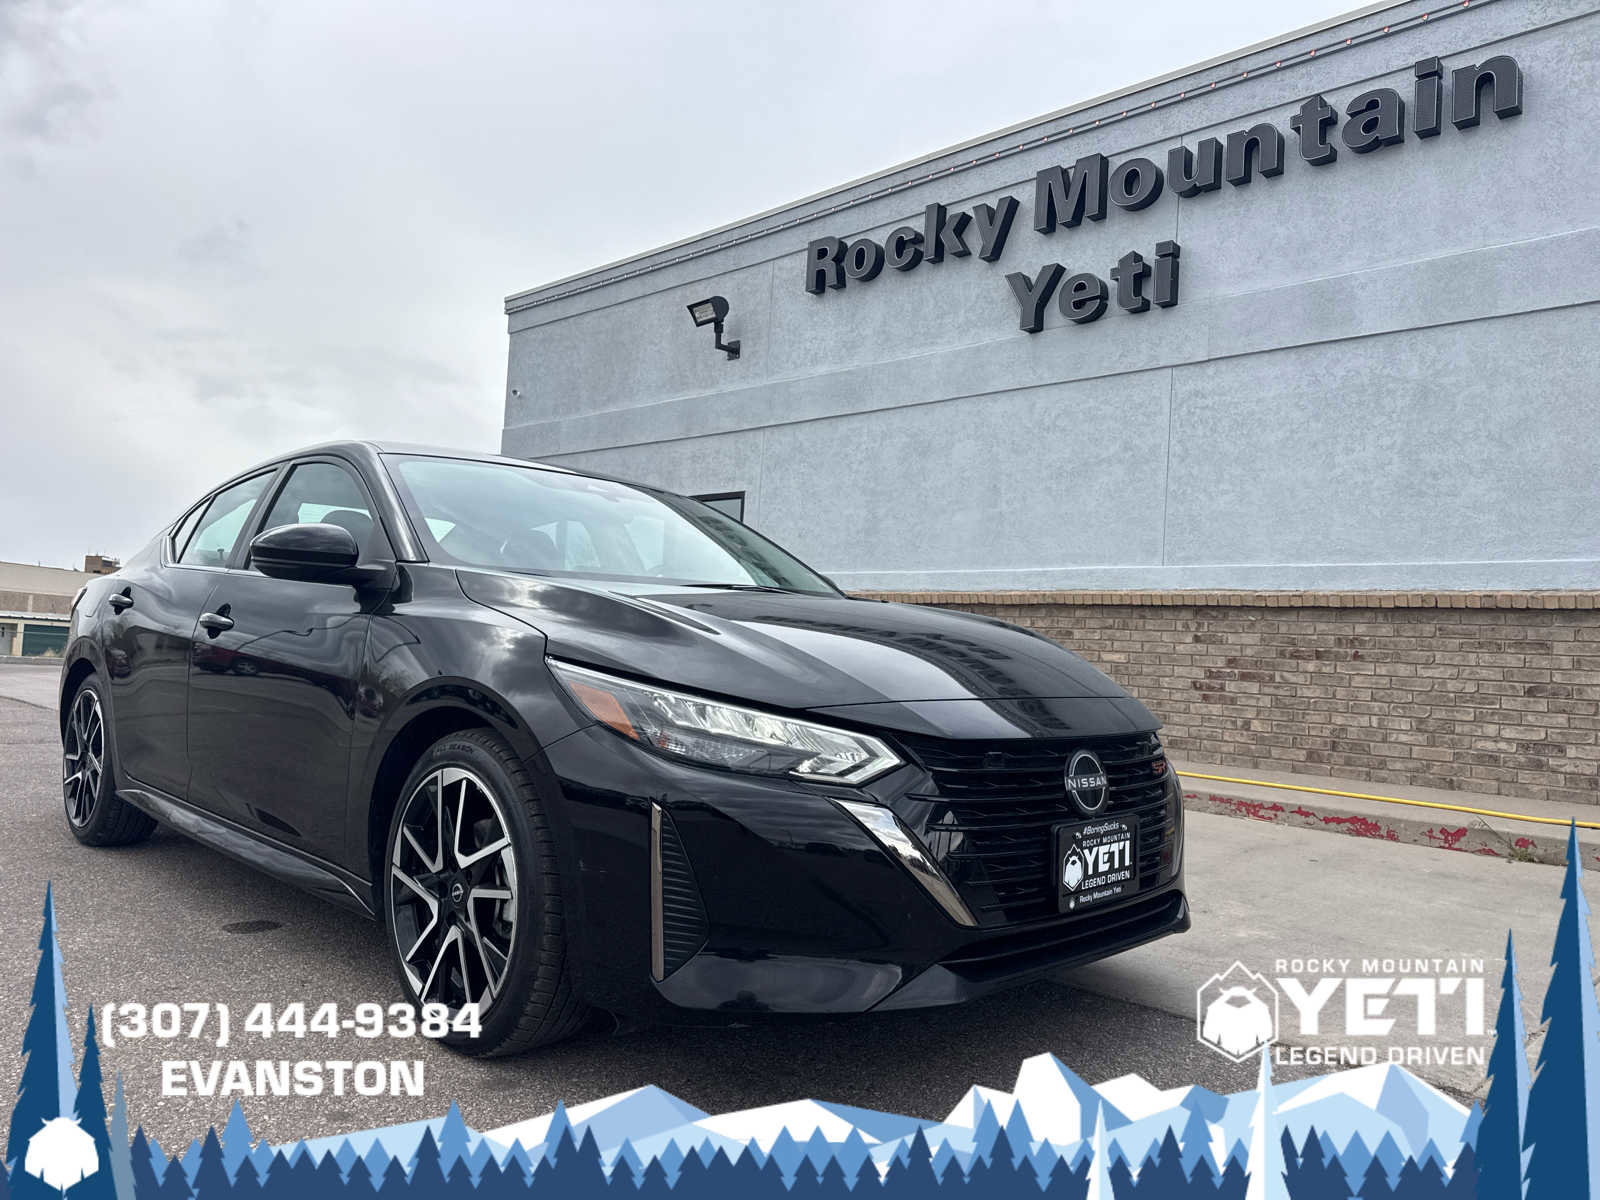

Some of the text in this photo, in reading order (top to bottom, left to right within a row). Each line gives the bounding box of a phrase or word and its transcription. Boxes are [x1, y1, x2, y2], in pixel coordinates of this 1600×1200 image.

[805, 54, 1523, 295] Rocky Mountain
[1005, 239, 1181, 334] Yeti
[1067, 775, 1107, 789] NISSAN
[1082, 832, 1131, 848] ROCKY MOUNTAIN
[1083, 840, 1131, 876] YETI
[1081, 870, 1131, 890] LEGEND DRIVEN
[1079, 894, 1093, 904] Rocky
